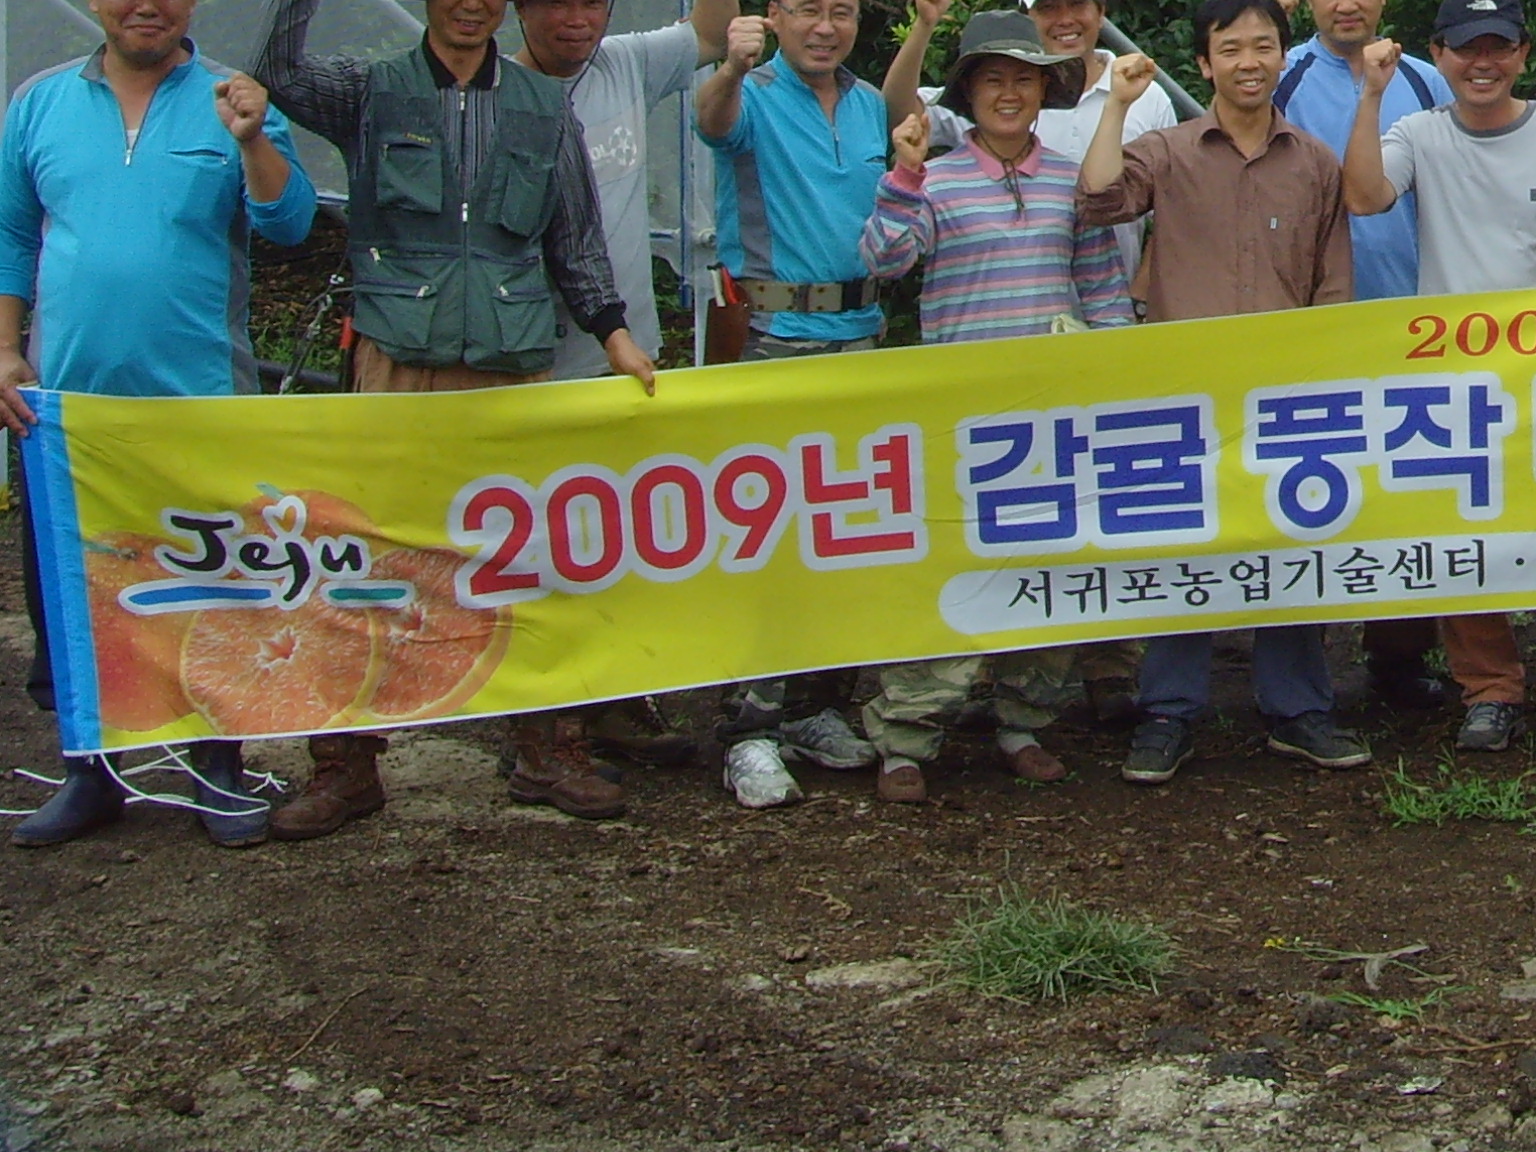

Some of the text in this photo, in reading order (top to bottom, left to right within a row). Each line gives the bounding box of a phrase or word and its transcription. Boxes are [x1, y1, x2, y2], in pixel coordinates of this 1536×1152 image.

[462, 435, 915, 596] 2009년
[968, 405, 1207, 546] 감귤
[1254, 384, 1503, 530] 풍작
[162, 513, 370, 602] Jeju
[1008, 538, 1488, 619] 서귀포농업기술센터
